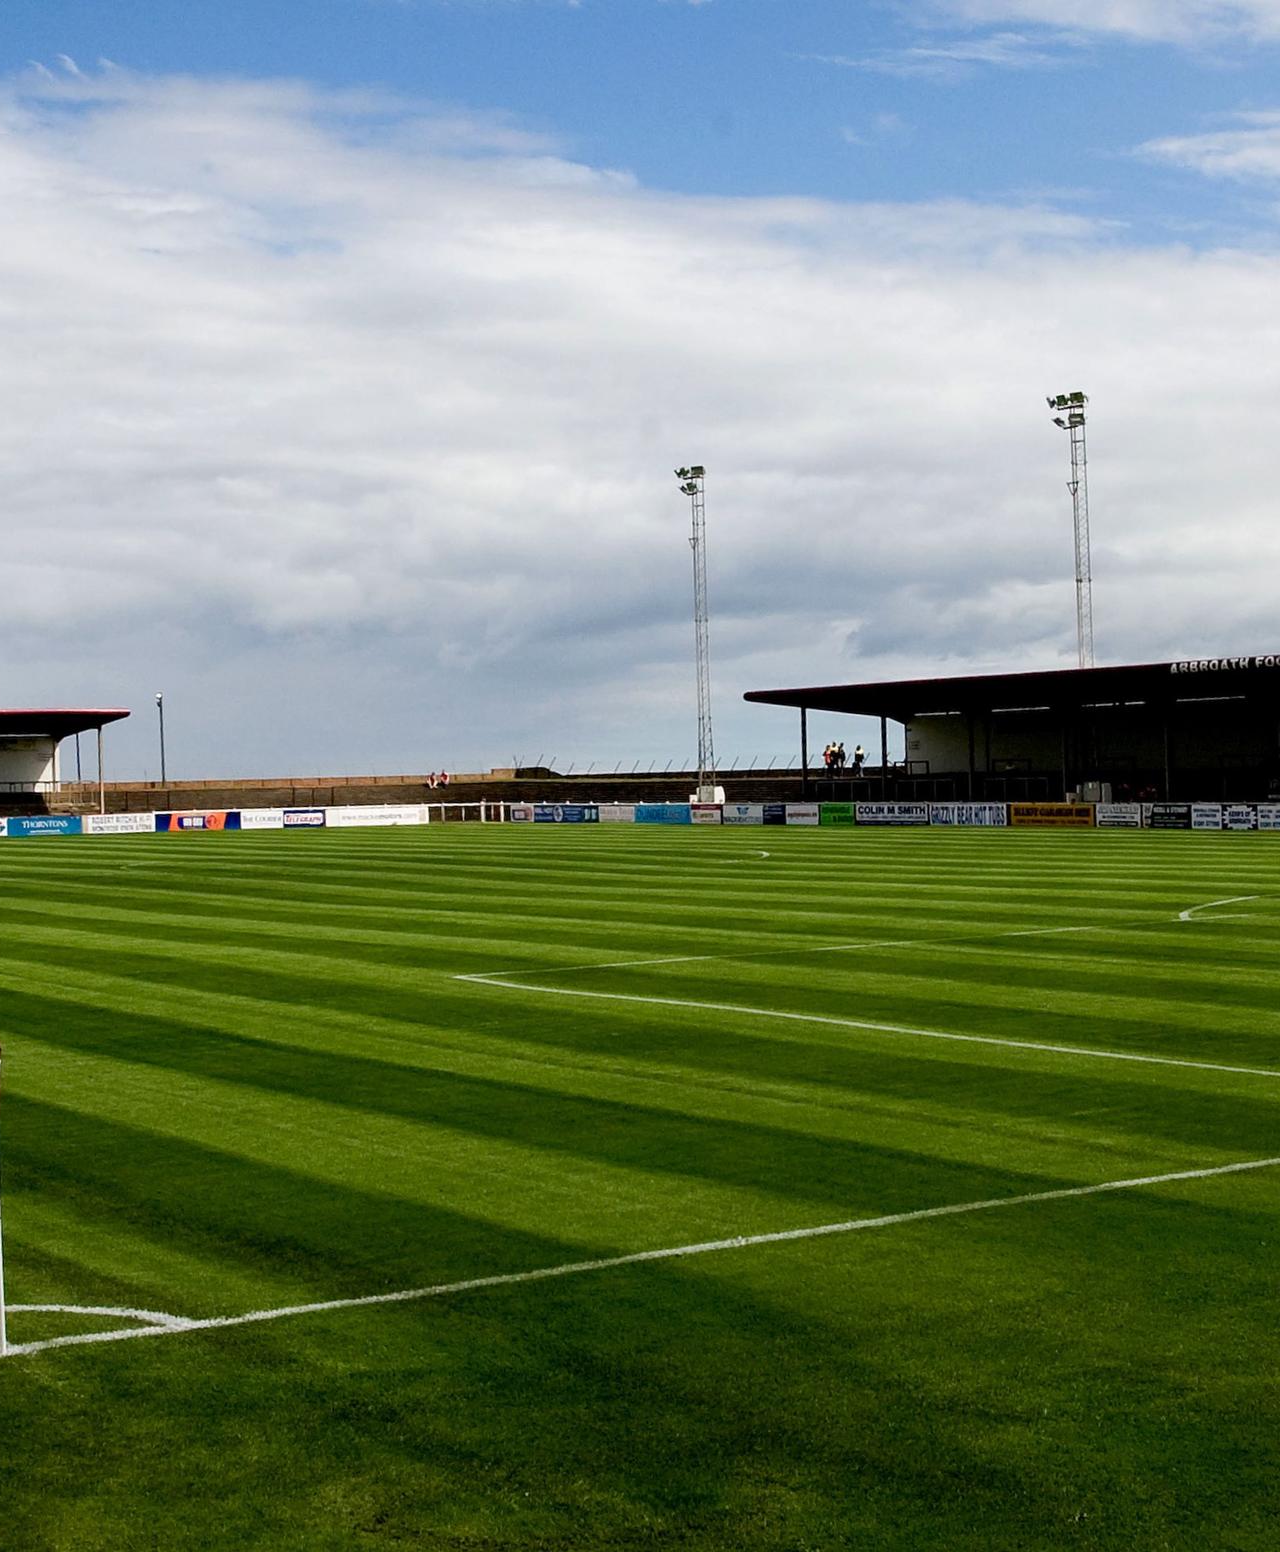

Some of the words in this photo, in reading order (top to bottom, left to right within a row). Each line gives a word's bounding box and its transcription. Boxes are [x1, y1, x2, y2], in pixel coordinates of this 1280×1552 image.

[1170, 656, 1249, 674] ARBROATH
[858, 806, 885, 814] COLIN
[887, 806, 896, 814] M
[897, 806, 926, 814] SMITH
[931, 804, 956, 824] GRIZZLY
[957, 804, 973, 824] BEAR
[22, 820, 68, 828] THORNTONS
